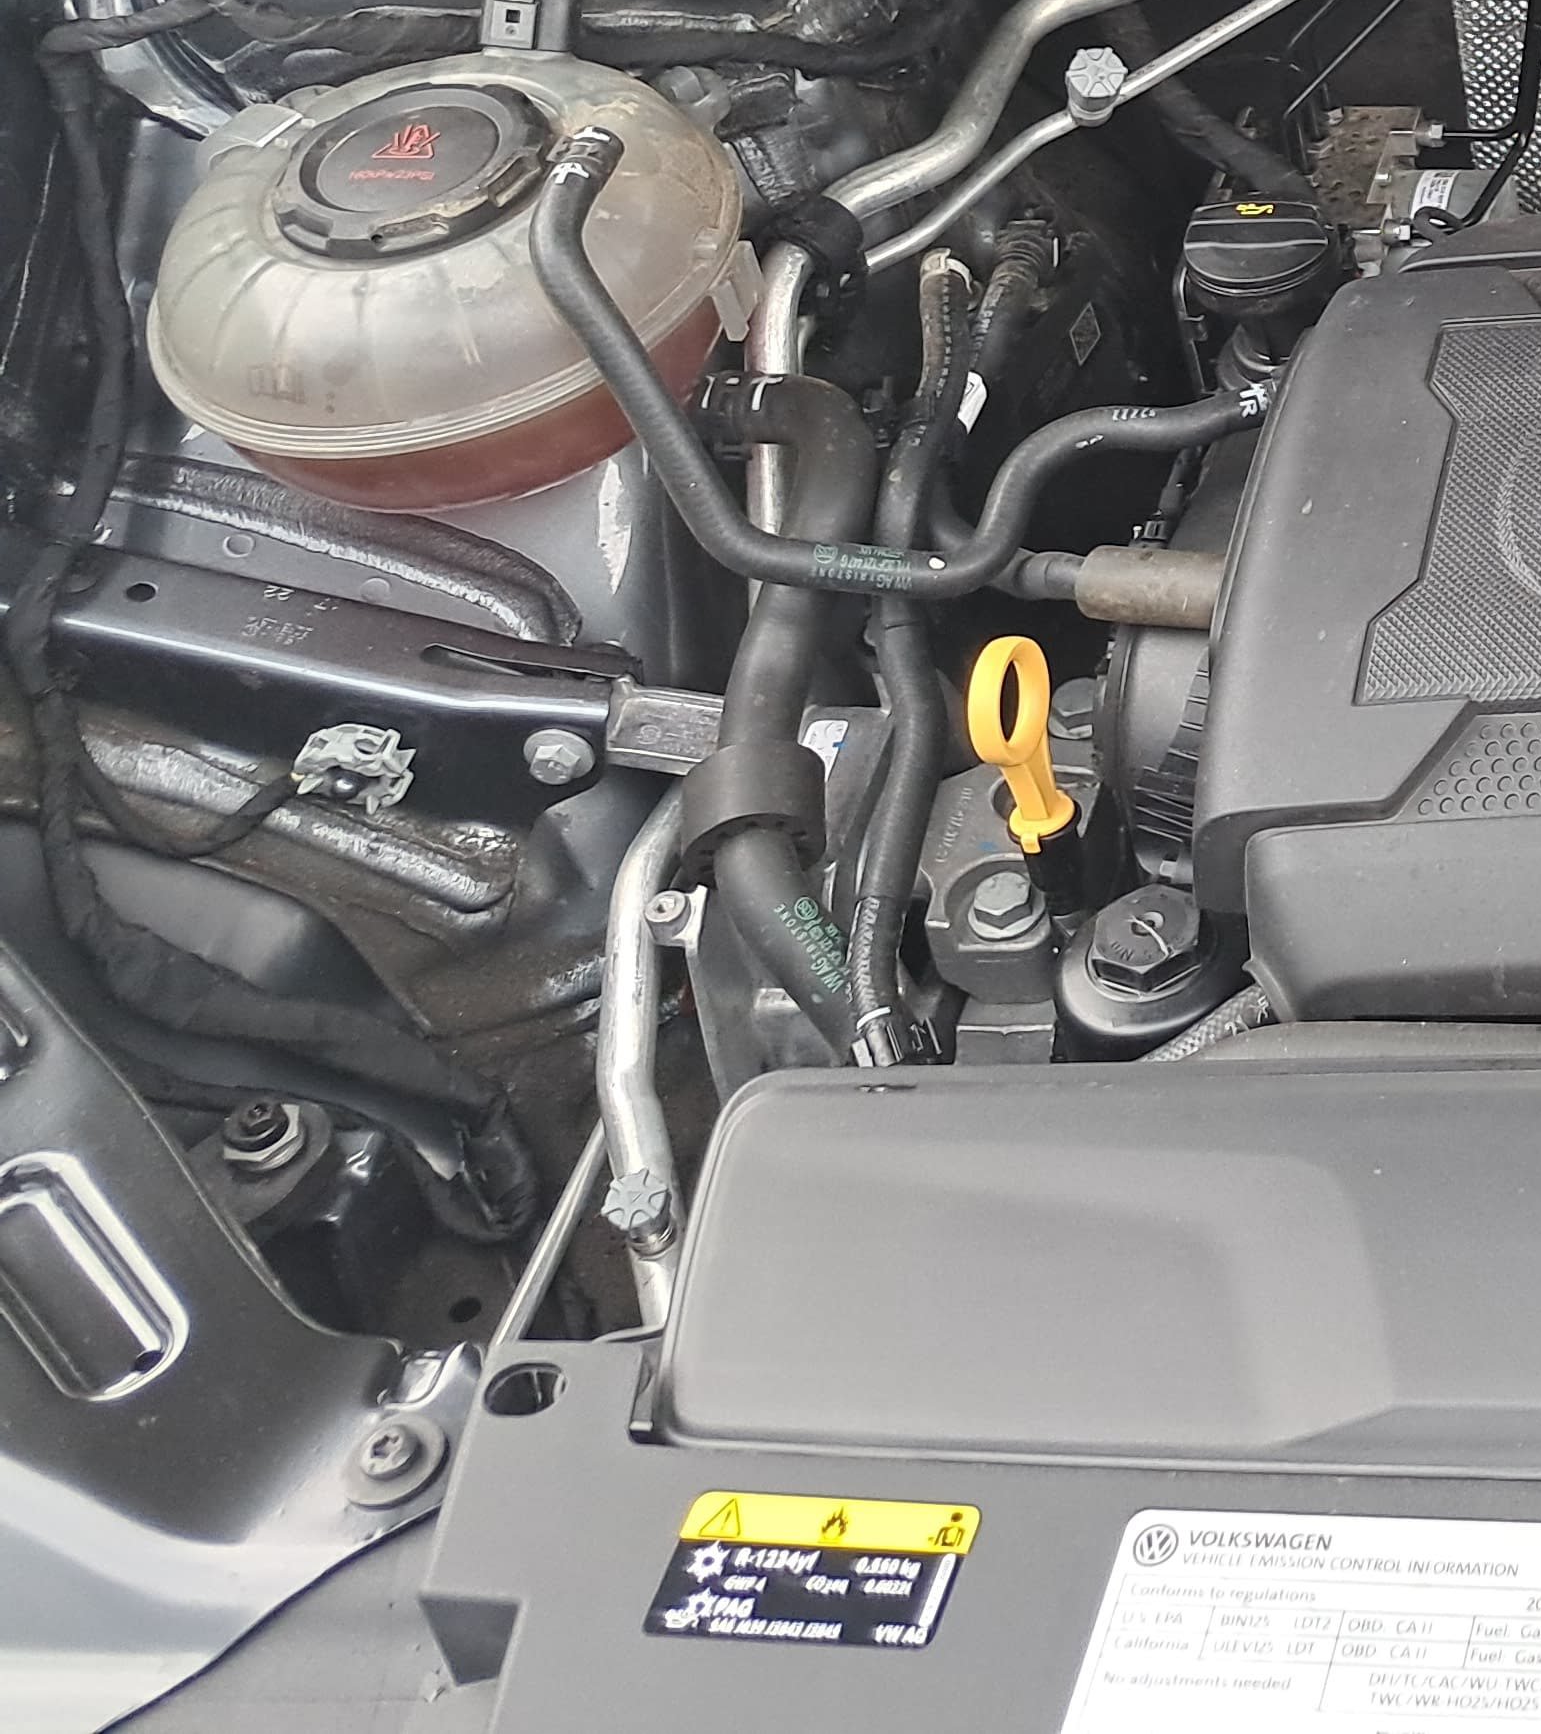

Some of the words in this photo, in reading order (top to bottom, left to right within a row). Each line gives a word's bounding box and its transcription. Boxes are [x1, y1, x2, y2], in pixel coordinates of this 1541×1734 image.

[1190, 1530, 1332, 1551] VOLKSWAGEN
[1330, 1557, 1401, 1573] CONTROL
[1407, 1560, 1519, 1577] INFORMATION
